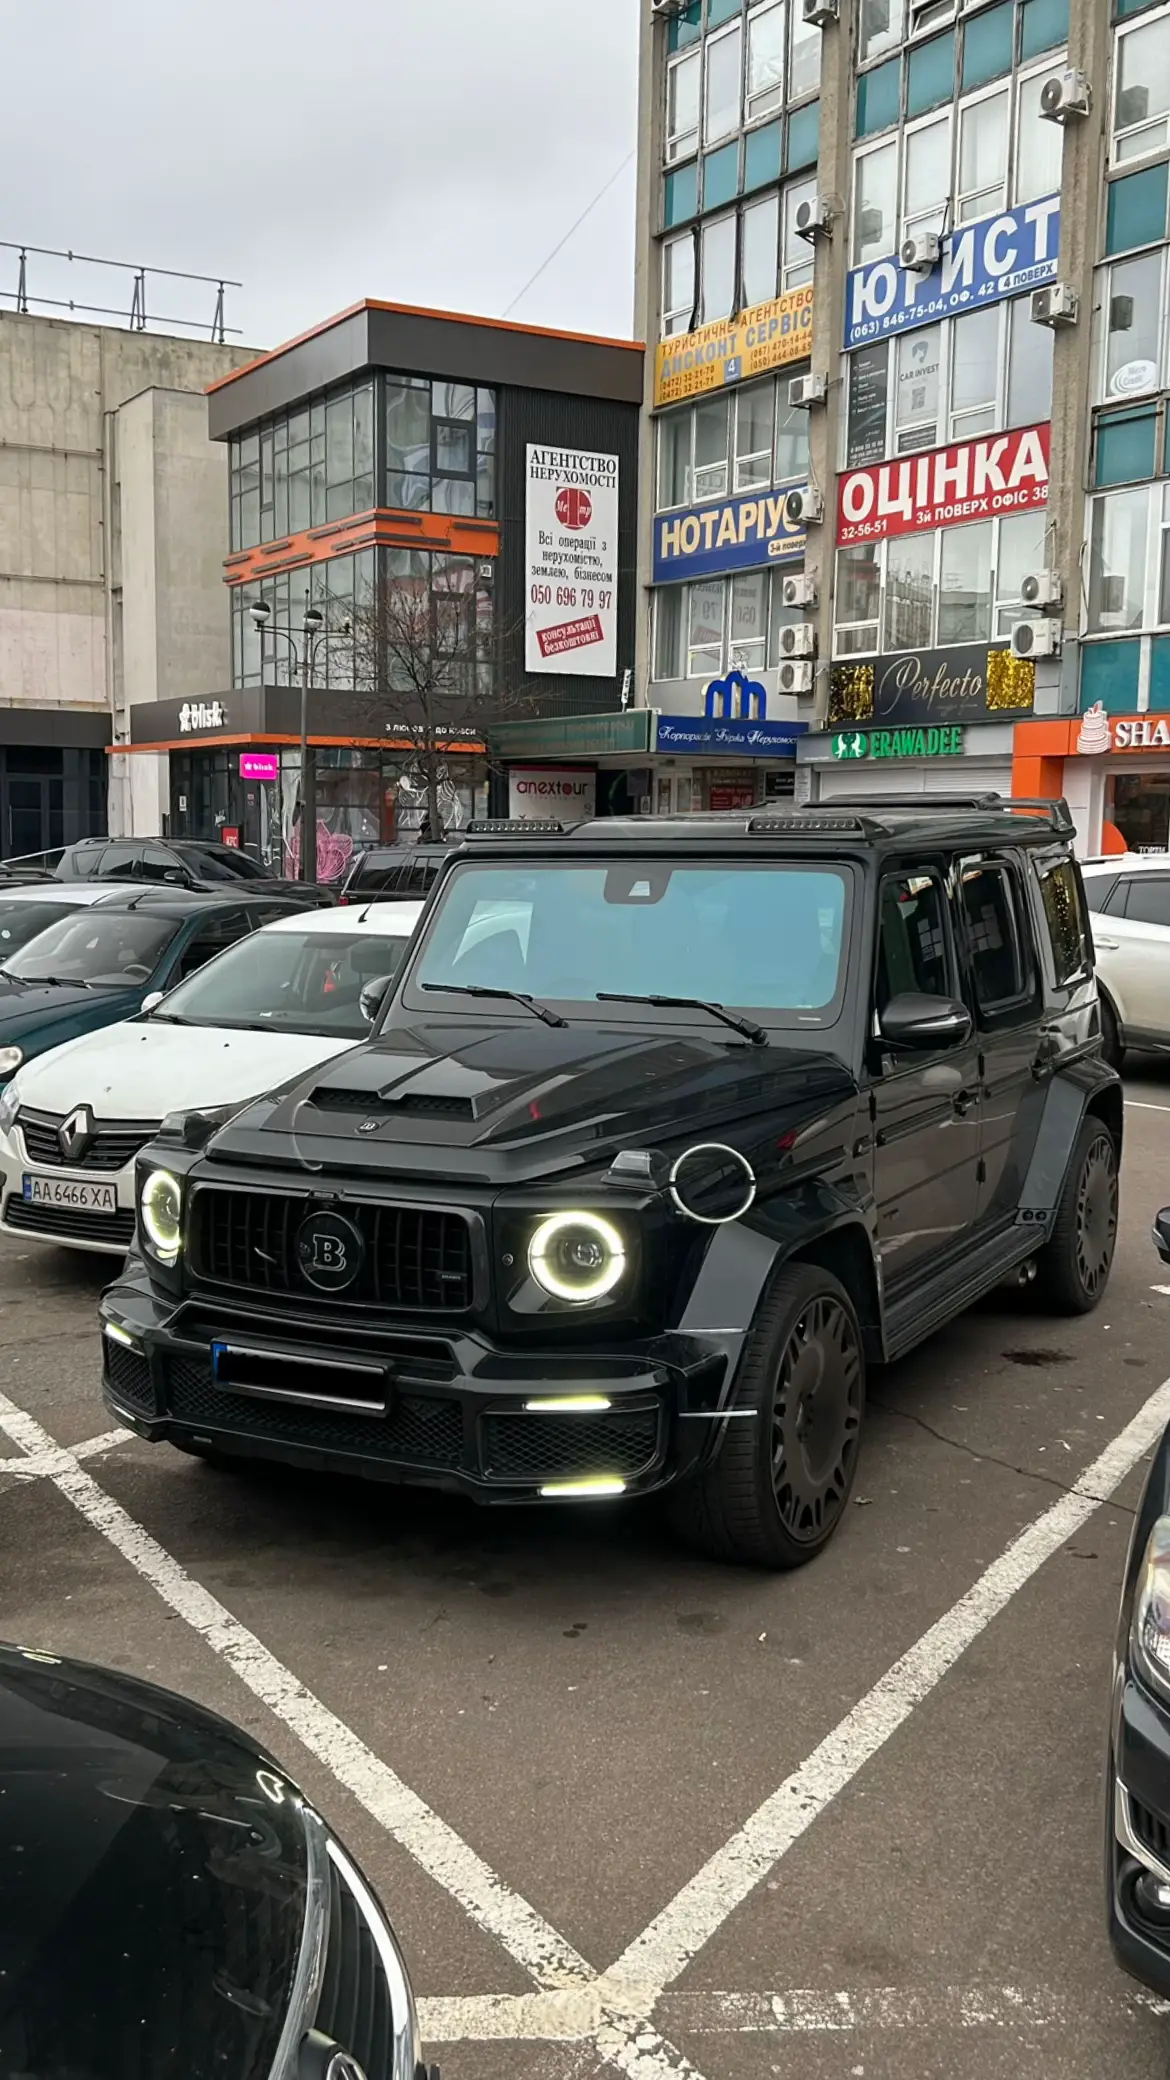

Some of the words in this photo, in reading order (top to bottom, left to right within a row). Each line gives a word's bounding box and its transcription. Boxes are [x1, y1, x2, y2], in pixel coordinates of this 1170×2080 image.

[852, 195, 1060, 324] ЮРИСТ
[1003, 276, 1012, 289] 4
[1013, 264, 1053, 285] ПОВЕРХ
[661, 321, 734, 356] ТУРИСТИЧНЕ
[740, 288, 813, 327] АГЕНТСТВО
[850, 320, 880, 342] (063)
[883, 298, 947, 330] 846-75-04,
[950, 291, 974, 307] ОФ.
[978, 282, 994, 297] 42
[661, 333, 737, 382] ДИСКОНТ
[745, 306, 812, 348] СЕРВІС
[728, 358, 736, 373] 4
[900, 371, 913, 382] CAR
[529, 448, 617, 475] АГЕНТСТВО
[530, 465, 616, 489] НЕРУХОМОСТІ
[842, 430, 1049, 523] ОЦІНКА
[934, 497, 988, 520] ПОВЕРХ
[991, 488, 1028, 508] ОФІС
[1031, 484, 1049, 500] 38
[538, 530, 553, 546] Всі
[558, 536, 597, 551] операції
[601, 542, 607, 551] з
[841, 518, 888, 540] 32-56-51
[542, 550, 603, 568] нерухомістю,
[531, 565, 569, 579] землею,
[574, 566, 613, 582] бізнесом
[530, 584, 551, 605] 050
[556, 587, 577, 607] 696
[581, 589, 594, 608] 79
[599, 591, 612, 609] 97
[541, 616, 596, 642] консультації
[544, 631, 600, 654] безкоштовні
[879, 656, 983, 716] Perfecto
[871, 727, 964, 759] ERAWADEE
[1115, 720, 1170, 747] SHA
[516, 780, 588, 796] anextour
[33, 1181, 52, 1201] AA
[55, 1183, 88, 1205] 6466
[90, 1187, 113, 1208] XA
